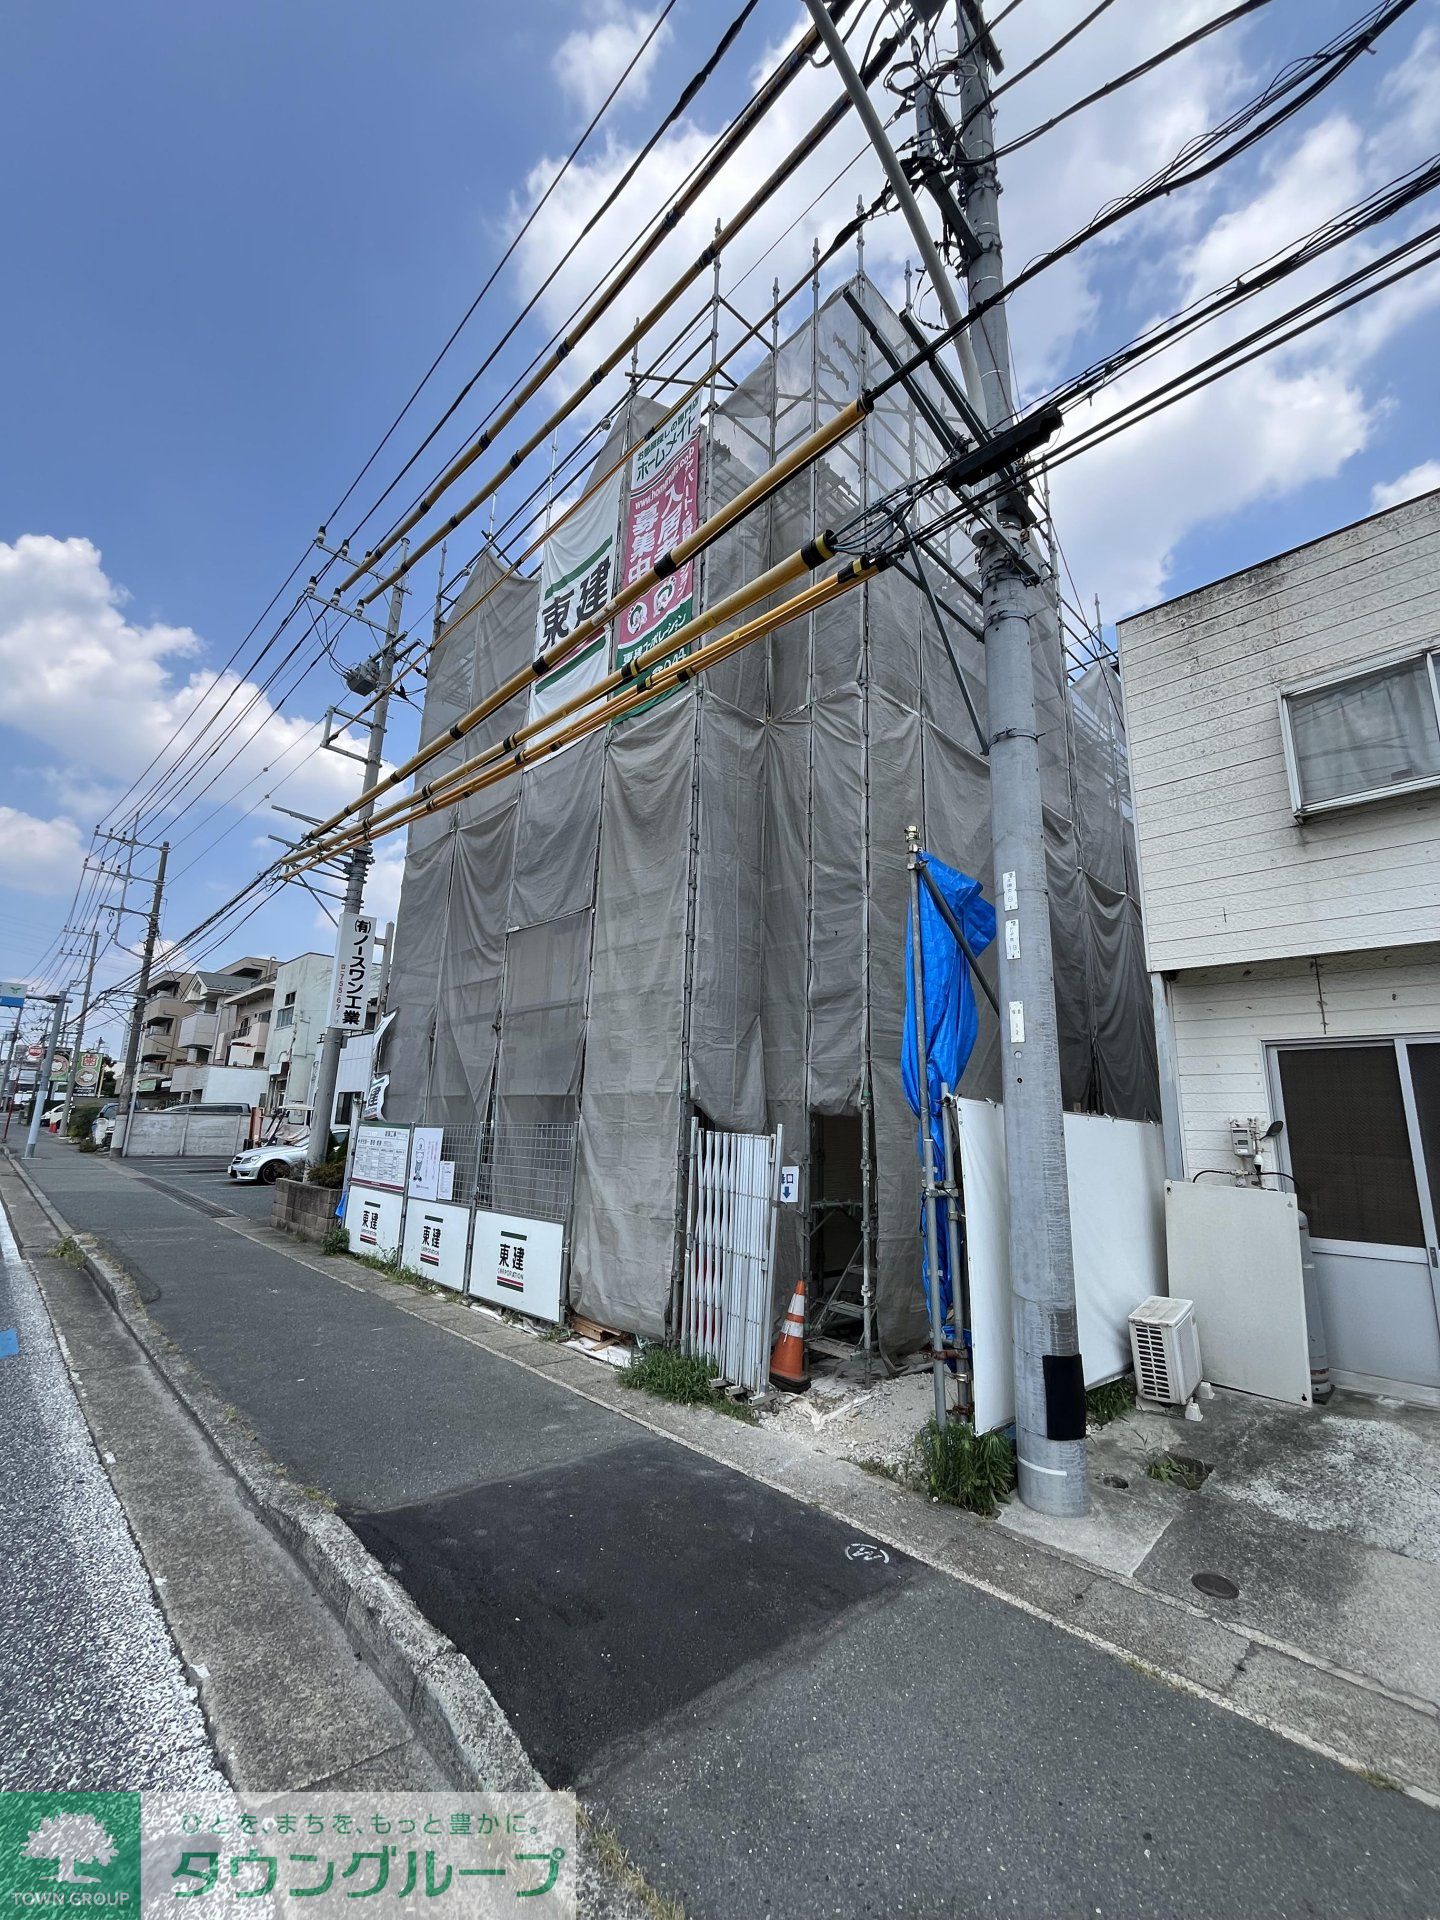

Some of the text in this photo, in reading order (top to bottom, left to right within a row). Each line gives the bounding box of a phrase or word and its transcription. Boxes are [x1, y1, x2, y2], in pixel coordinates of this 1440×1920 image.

[637, 414, 697, 481] ホームメイト
[628, 501, 660, 584] 募集中
[537, 555, 612, 657] 東建
[361, 1210, 379, 1230] 東建
[421, 1225, 441, 1248] 東建
[498, 1243, 525, 1271] 東建
